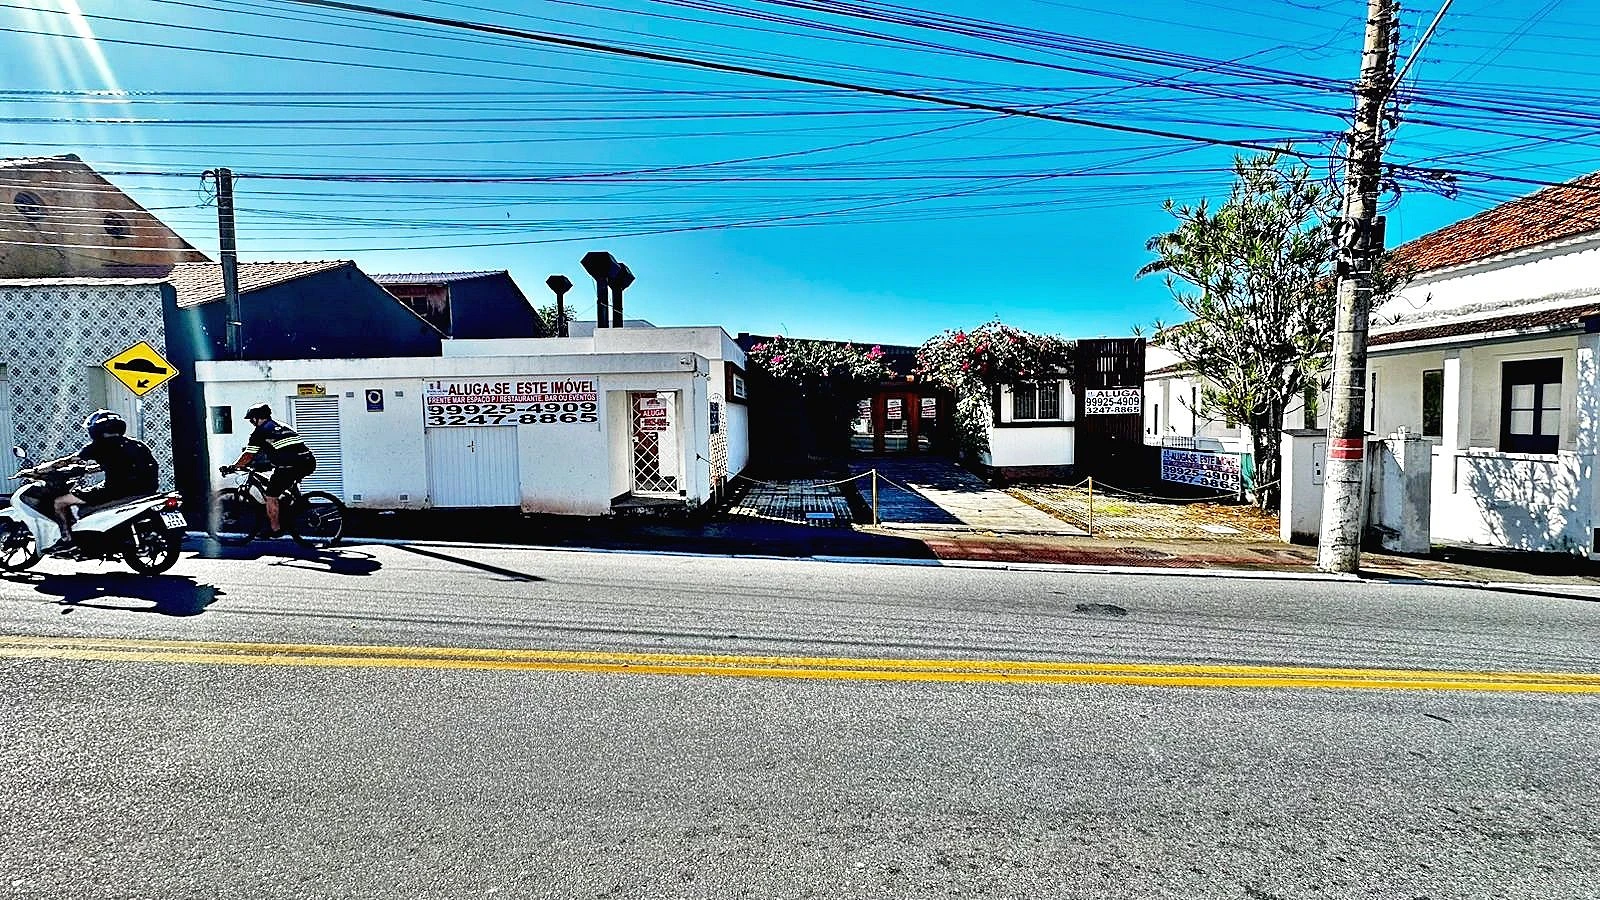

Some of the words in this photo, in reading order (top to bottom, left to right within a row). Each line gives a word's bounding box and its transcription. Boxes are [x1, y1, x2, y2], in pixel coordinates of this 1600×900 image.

[448, 382, 511, 396] ALUGA-SE
[516, 381, 548, 394] ESTE
[551, 378, 597, 393] IMÓVEL
[452, 396, 466, 404] MAR
[544, 394, 558, 402] BAR
[558, 394, 568, 402] OU
[568, 393, 596, 401] EVENTOS
[1096, 389, 1140, 398] ALUGA
[1085, 397, 1140, 406] 99925-4909
[428, 402, 597, 415] 99925-4909
[643, 409, 665, 417] ALUGA
[1086, 406, 1140, 414] 3247-8865
[428, 413, 598, 426] 3247-8865
[1199, 455, 1217, 465] ESTE
[1162, 465, 1240, 482] 99925-4909
[1162, 473, 1240, 491] 3247-8865
